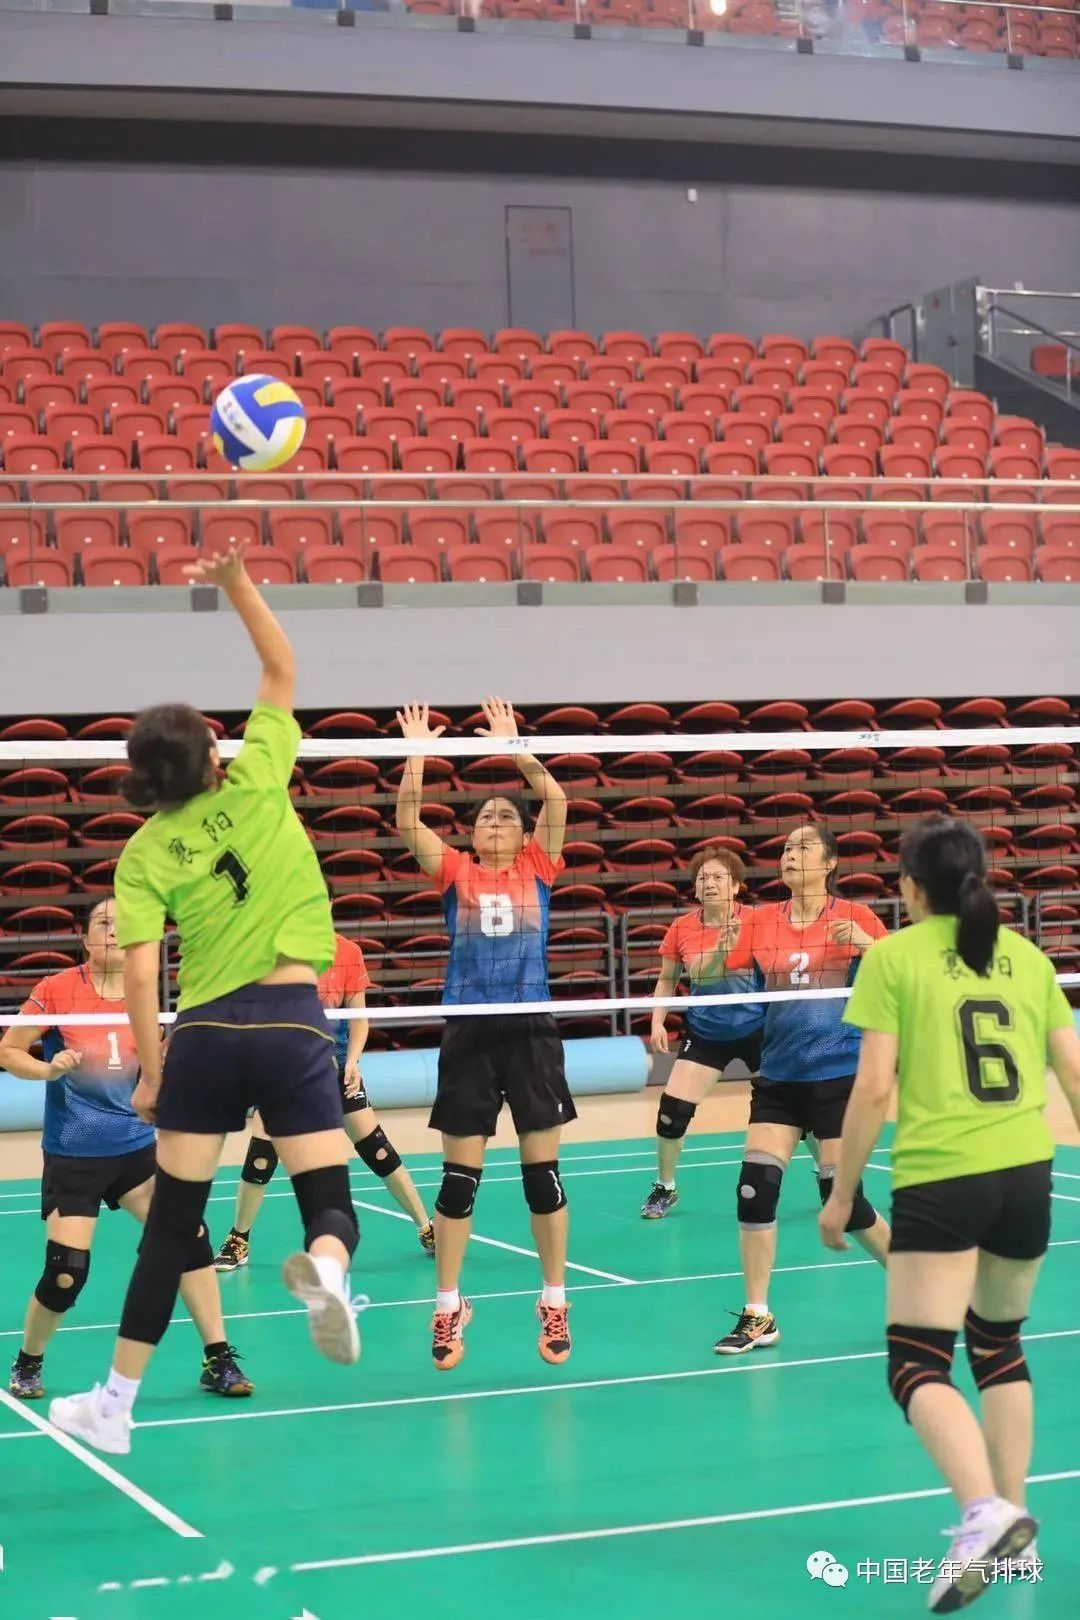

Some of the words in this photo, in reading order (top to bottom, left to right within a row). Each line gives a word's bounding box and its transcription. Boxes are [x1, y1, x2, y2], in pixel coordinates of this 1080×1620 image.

[211, 846, 251, 908] 1
[479, 893, 514, 937] 8
[788, 952, 810, 984] 2
[107, 1031, 121, 1066] 1
[954, 995, 1024, 1107] 6
